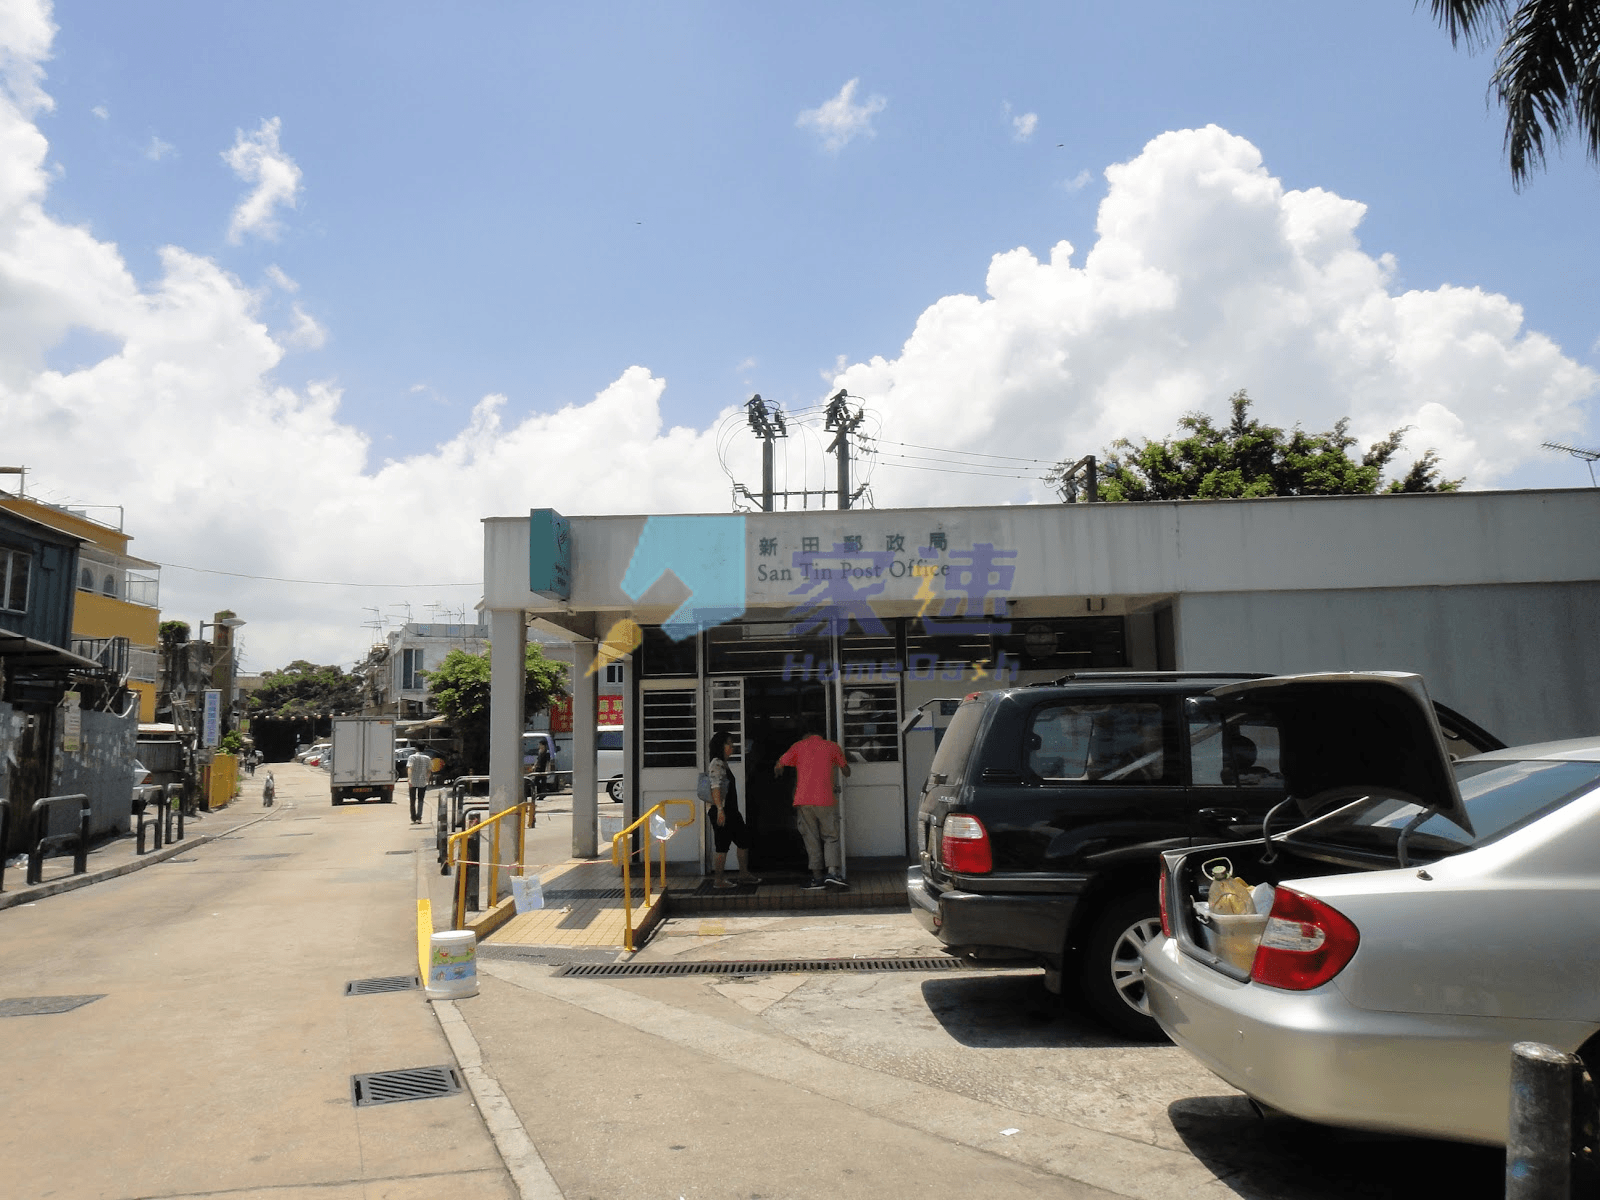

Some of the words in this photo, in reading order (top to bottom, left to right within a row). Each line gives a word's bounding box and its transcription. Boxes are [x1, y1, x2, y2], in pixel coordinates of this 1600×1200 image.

[758, 532, 948, 557] 新田郵政局
[757, 563, 793, 582] San
[799, 561, 833, 581] Tin
[840, 561, 882, 580] Post
[888, 558, 951, 578] Office
